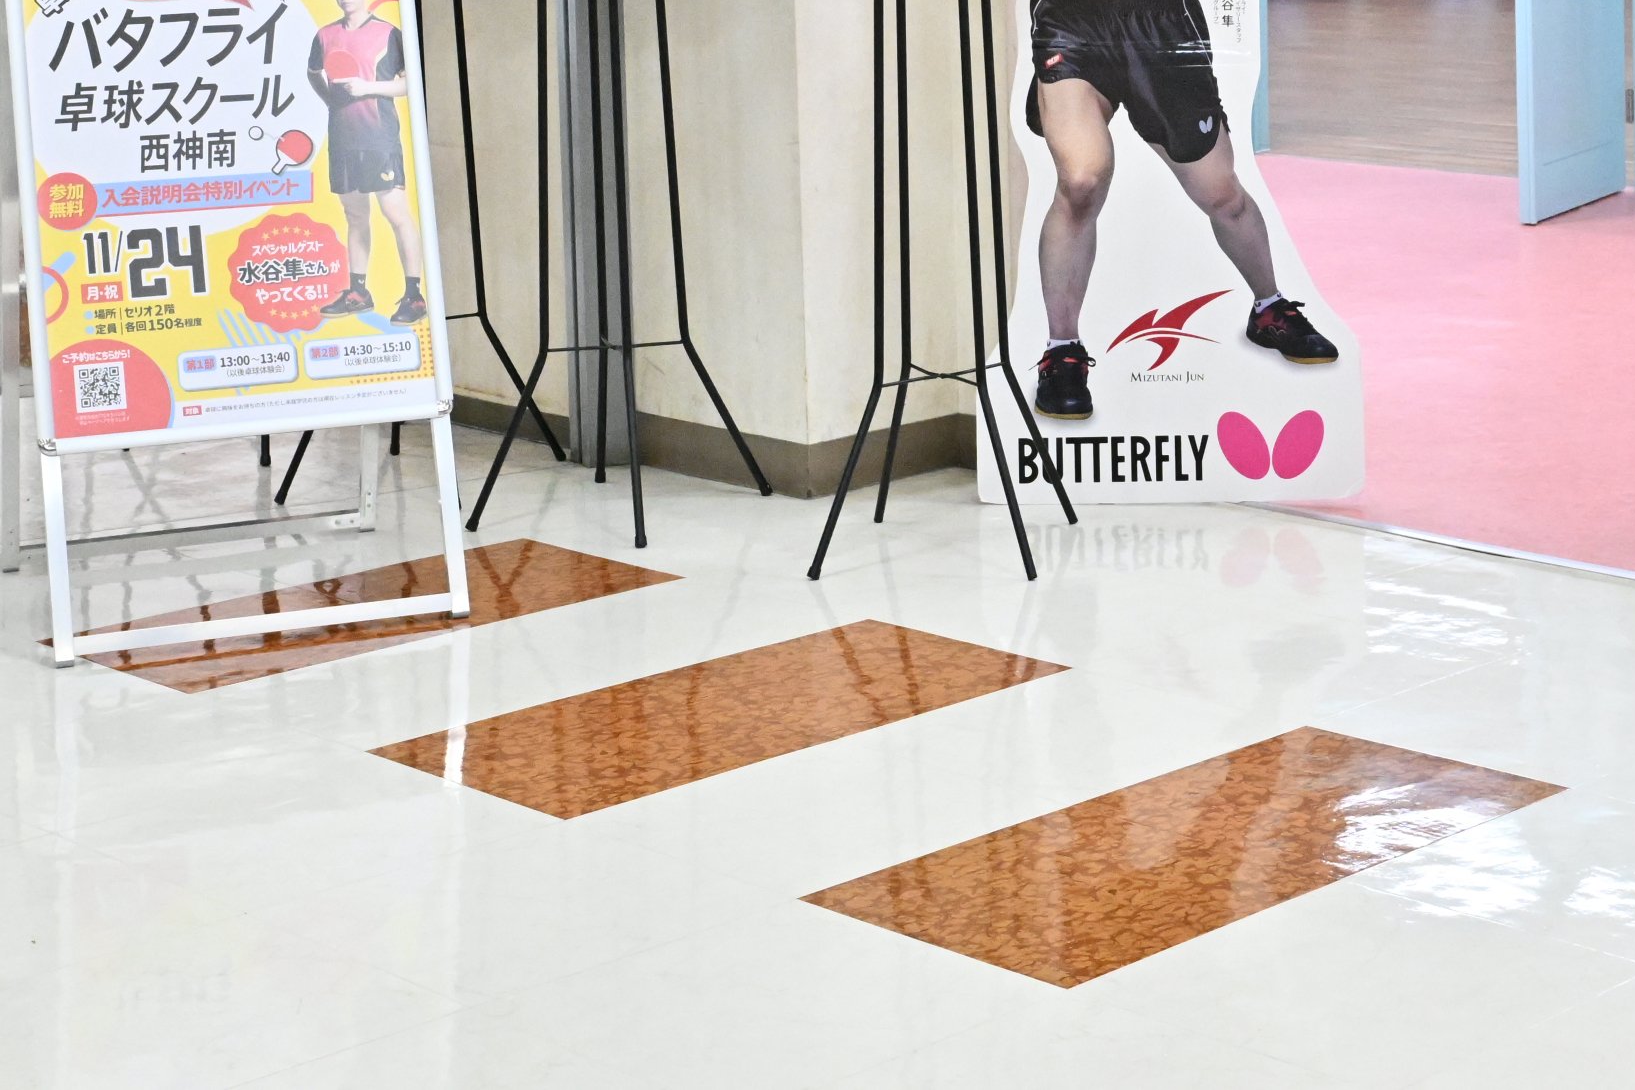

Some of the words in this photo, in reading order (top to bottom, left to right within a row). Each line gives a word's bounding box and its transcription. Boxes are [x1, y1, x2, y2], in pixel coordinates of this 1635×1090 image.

[48, 3, 288, 73] バタフライ
[54, 75, 295, 132] 卓球スクール
[139, 129, 236, 173] 西神南
[49, 183, 84, 201] 参加
[102, 179, 299, 208] 入会説明会特別イベント
[49, 200, 85, 218] 無料
[252, 240, 324, 257] スペシャルゲスト
[82, 225, 208, 299] 11/24
[256, 284, 329, 305] やってくる!!
[94, 308, 116, 320] 場所
[124, 304, 176, 319] セリオ2階
[95, 323, 117, 335] 定員
[125, 318, 202, 333] 各回150名程度
